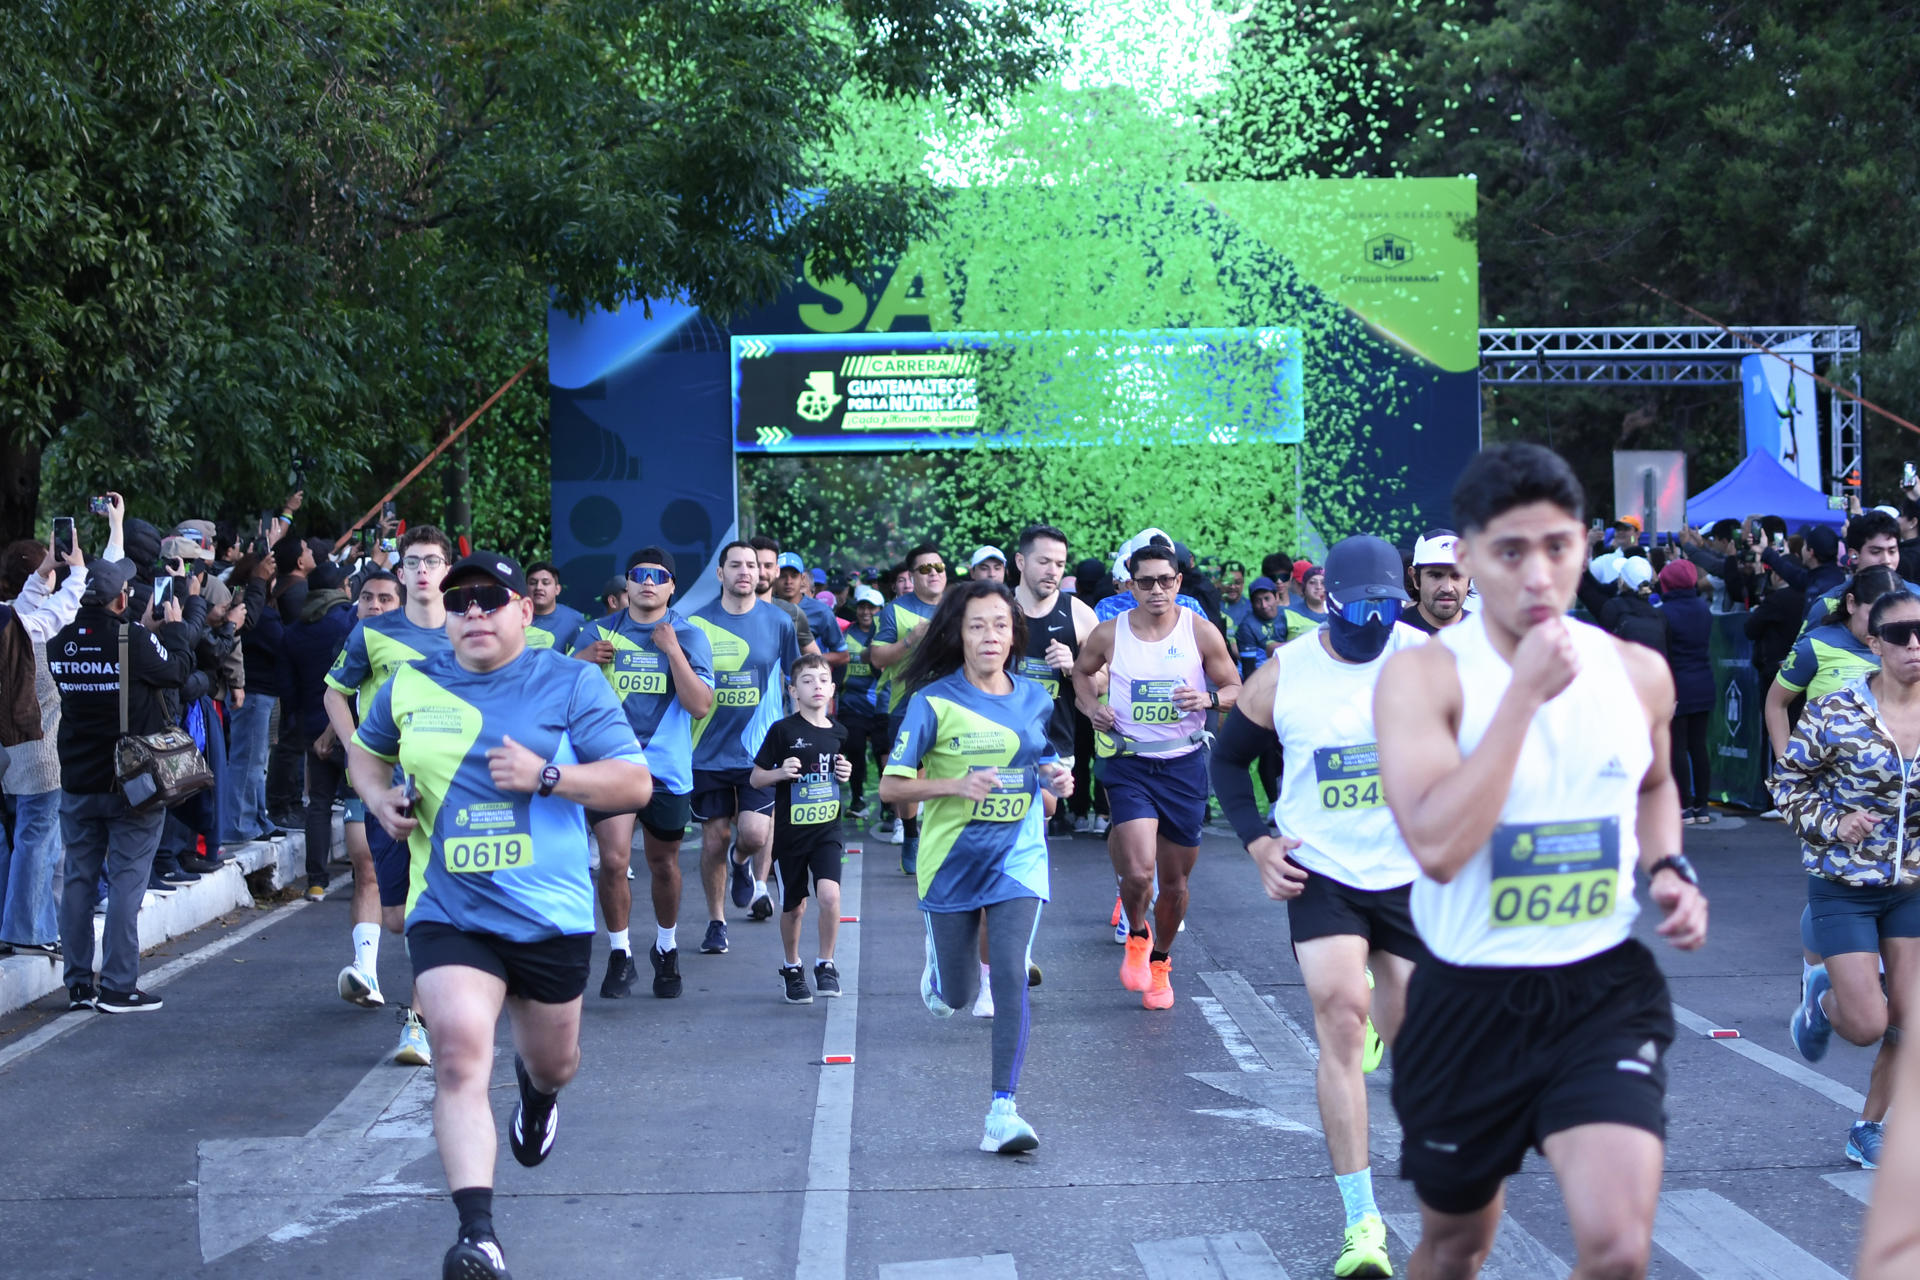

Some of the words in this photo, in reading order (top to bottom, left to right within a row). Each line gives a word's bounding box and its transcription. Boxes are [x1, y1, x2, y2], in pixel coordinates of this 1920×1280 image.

[872, 359, 949, 372] CARRERA
[847, 378, 976, 396] GUATEMALTECOS
[847, 397, 872, 410] POR
[873, 397, 888, 410] LA
[51, 661, 120, 674] PETRONAS
[619, 675, 660, 691] 0691
[717, 691, 756, 705] 0682
[1323, 782, 1384, 808] 034
[794, 804, 837, 822] 0693
[972, 798, 1023, 818] 1530
[453, 840, 522, 868] 0619
[1494, 878, 1611, 922] 0646
